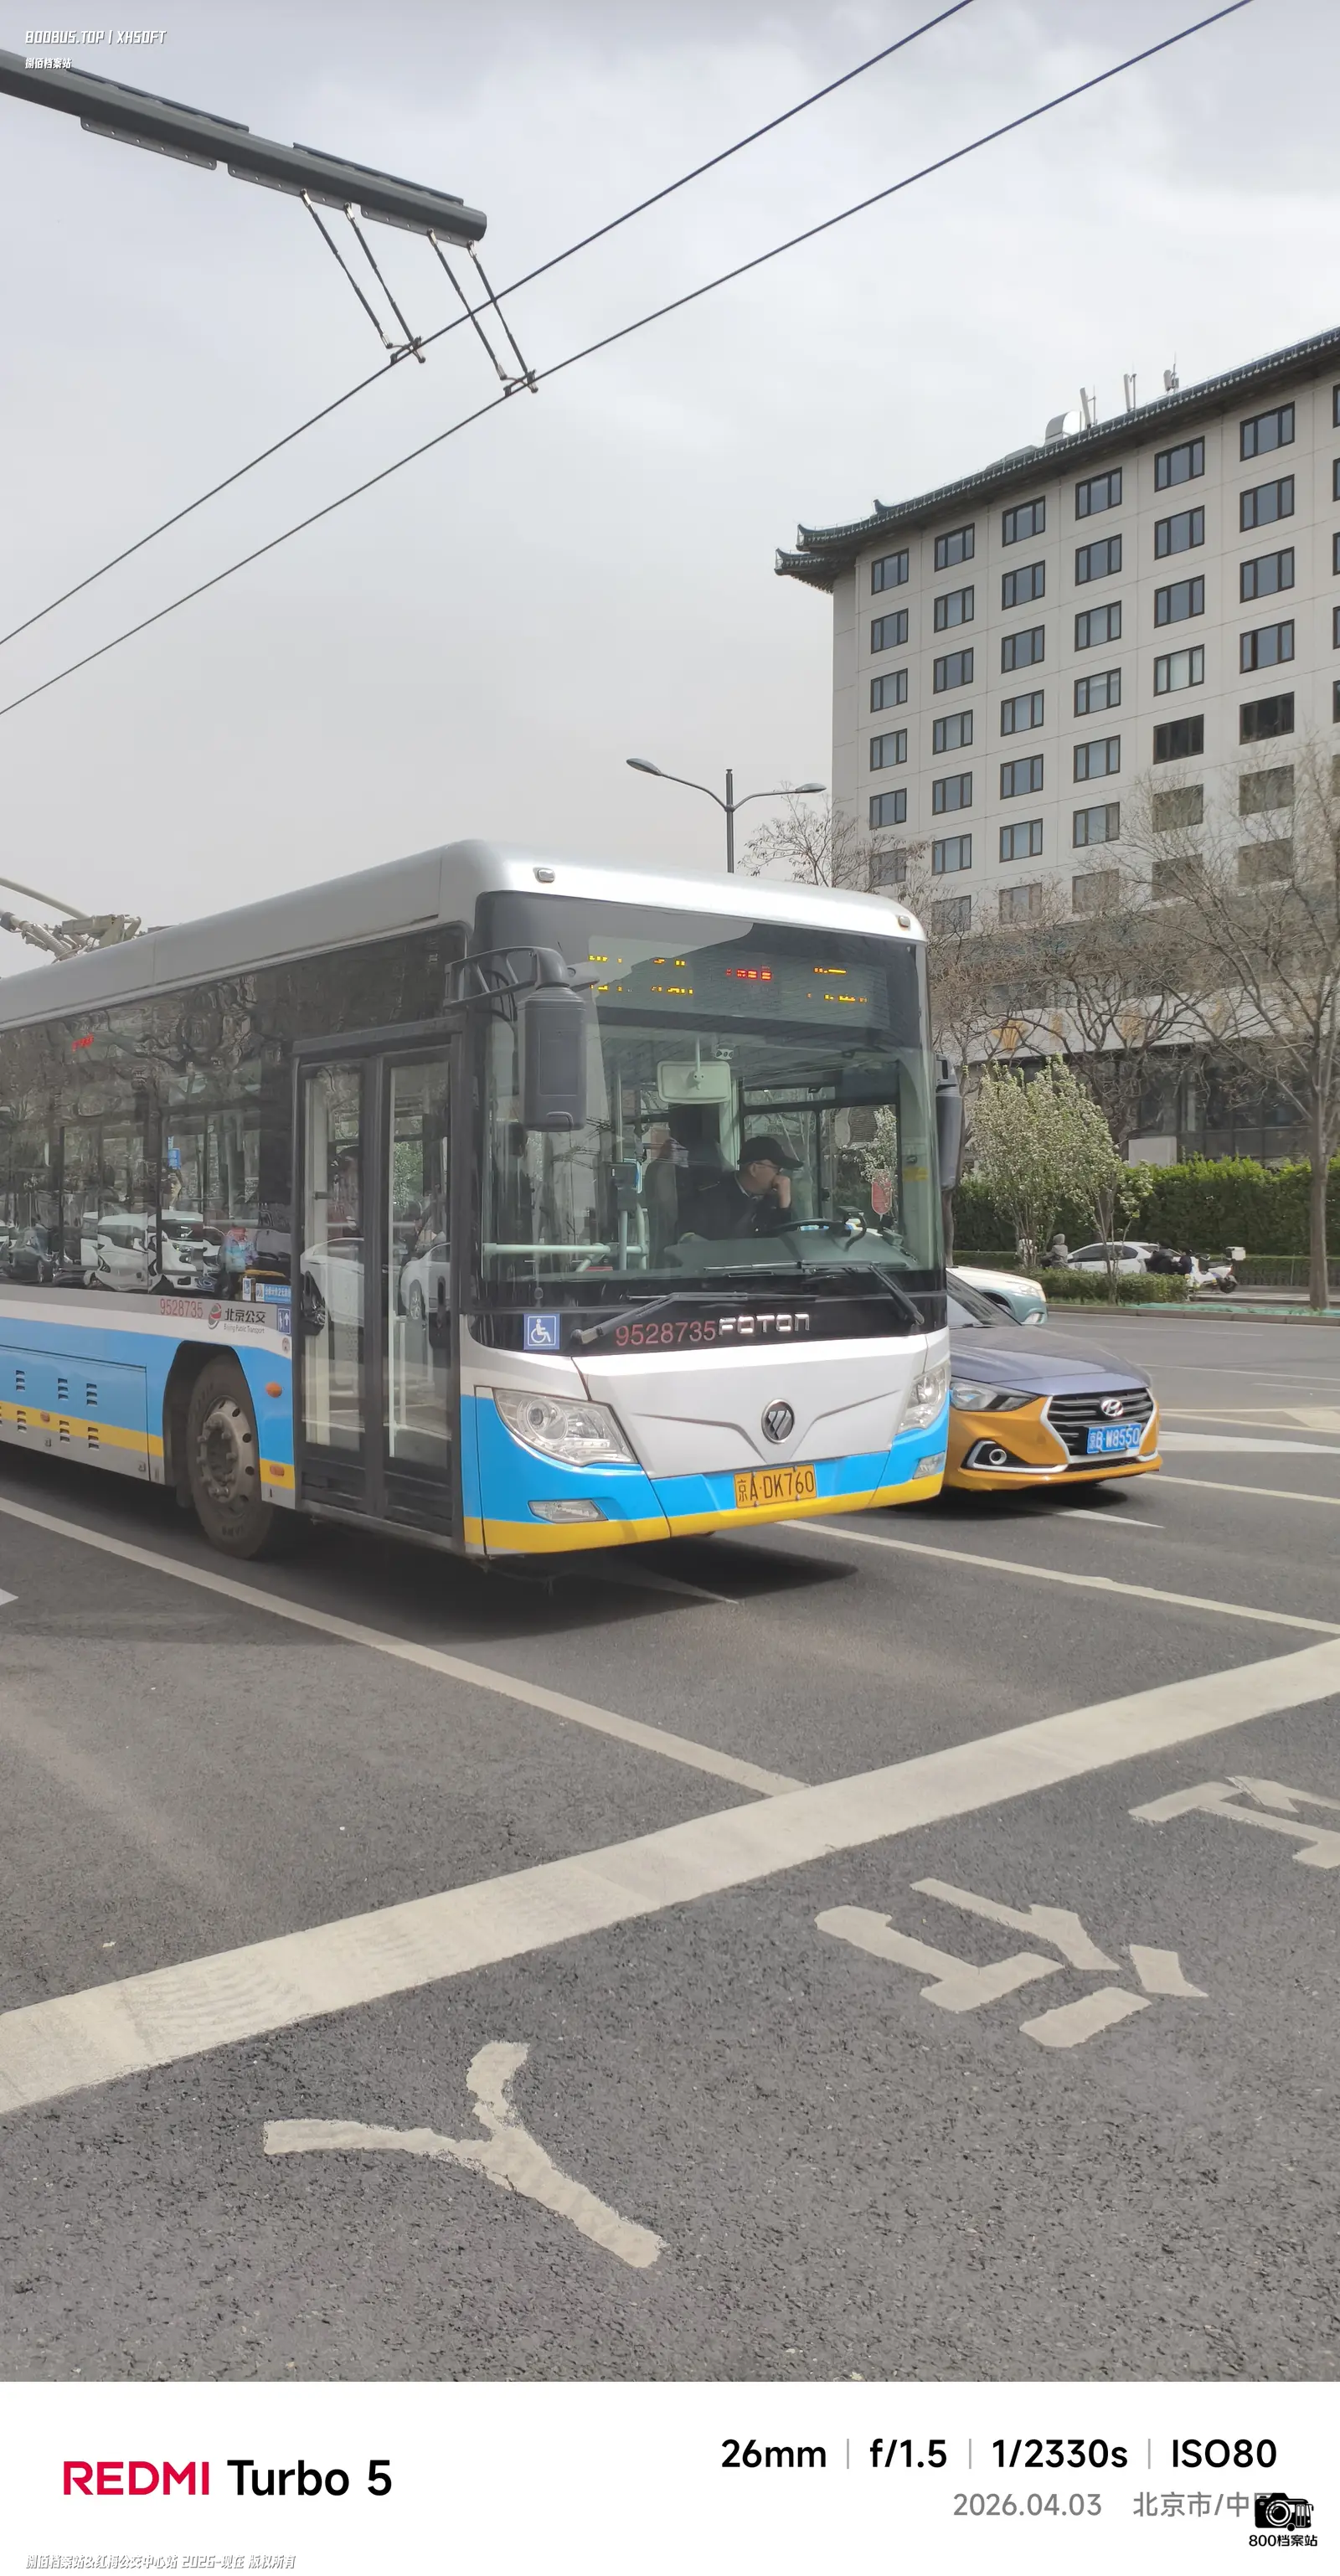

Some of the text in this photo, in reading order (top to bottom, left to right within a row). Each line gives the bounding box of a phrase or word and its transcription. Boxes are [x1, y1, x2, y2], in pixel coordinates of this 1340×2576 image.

[160, 1299, 203, 1318] 9528735
[225, 1308, 266, 1323] 北京公交
[614, 1313, 810, 1347] 9528735 FOTON
